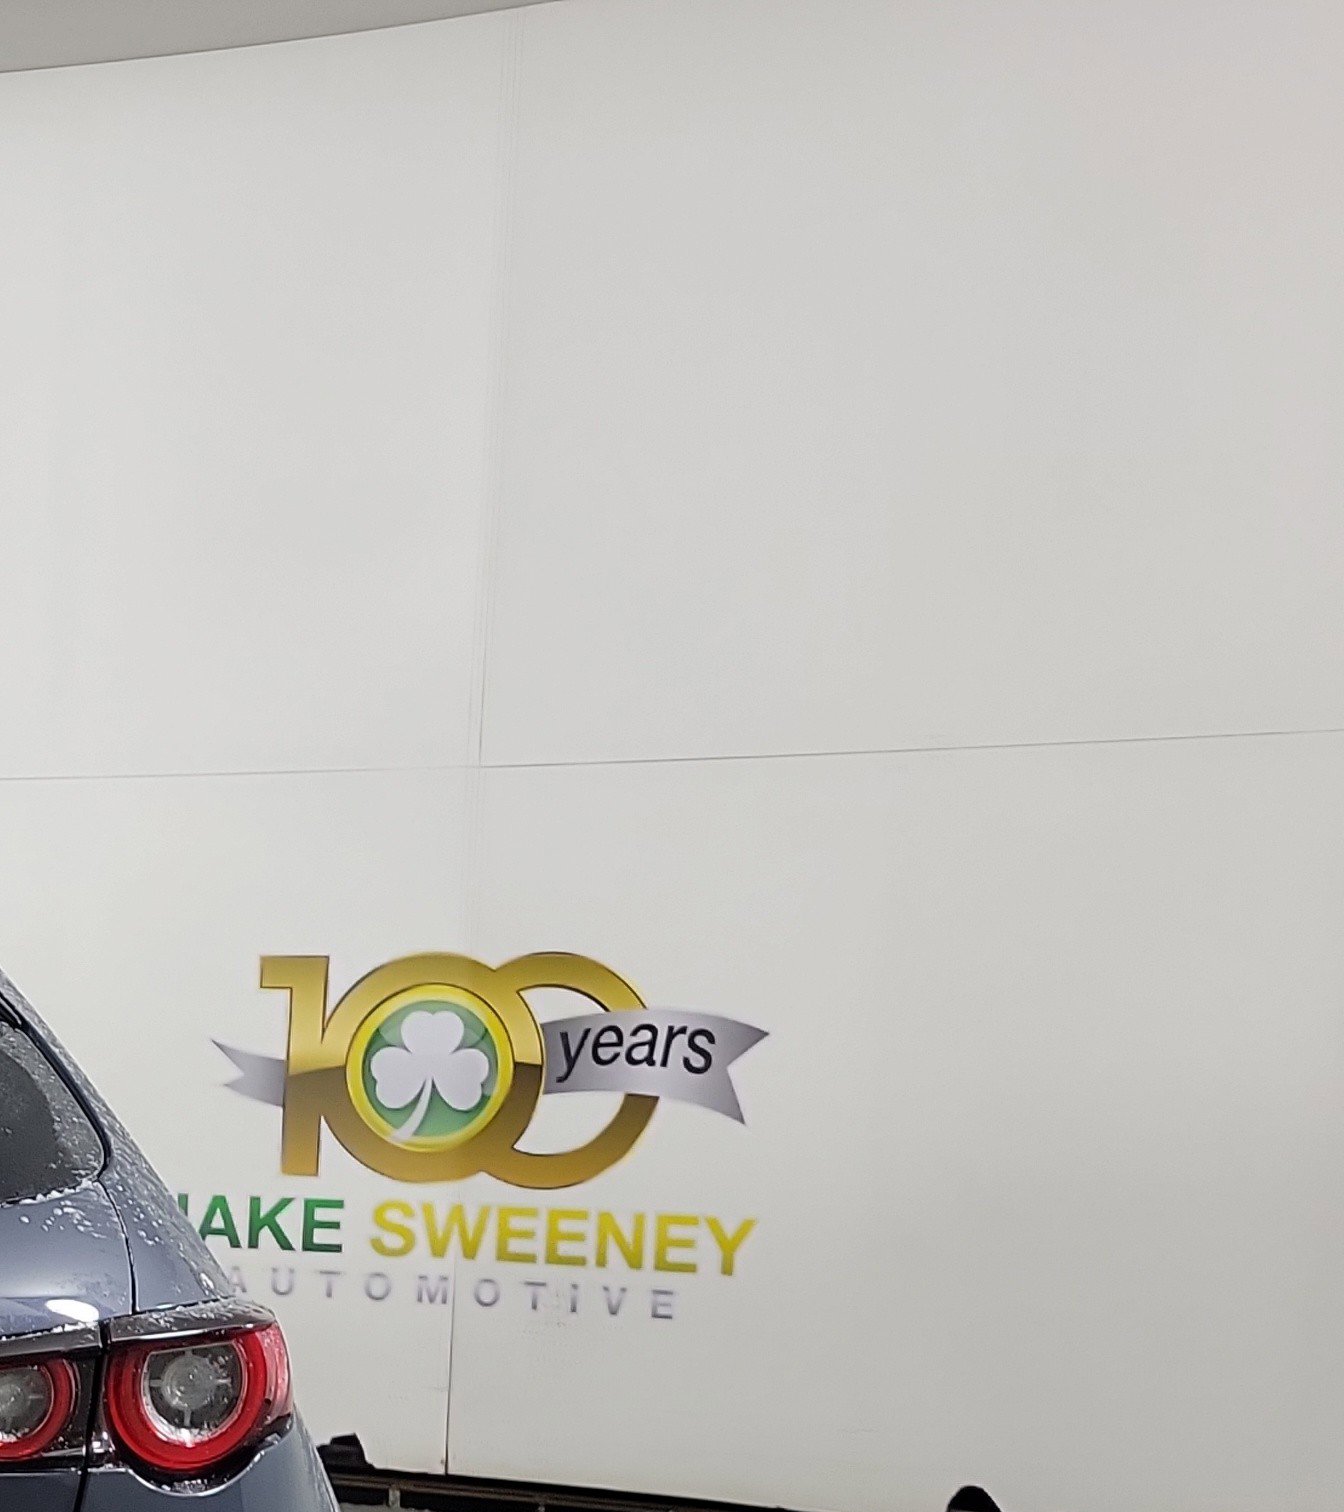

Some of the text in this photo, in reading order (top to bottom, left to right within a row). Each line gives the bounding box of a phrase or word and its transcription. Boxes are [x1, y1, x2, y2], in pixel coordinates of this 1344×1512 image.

[259, 951, 717, 1189] 100 years
[369, 1199, 757, 1276] SWEENEY
[227, 1264, 678, 1320] AUTOMOTIVE
